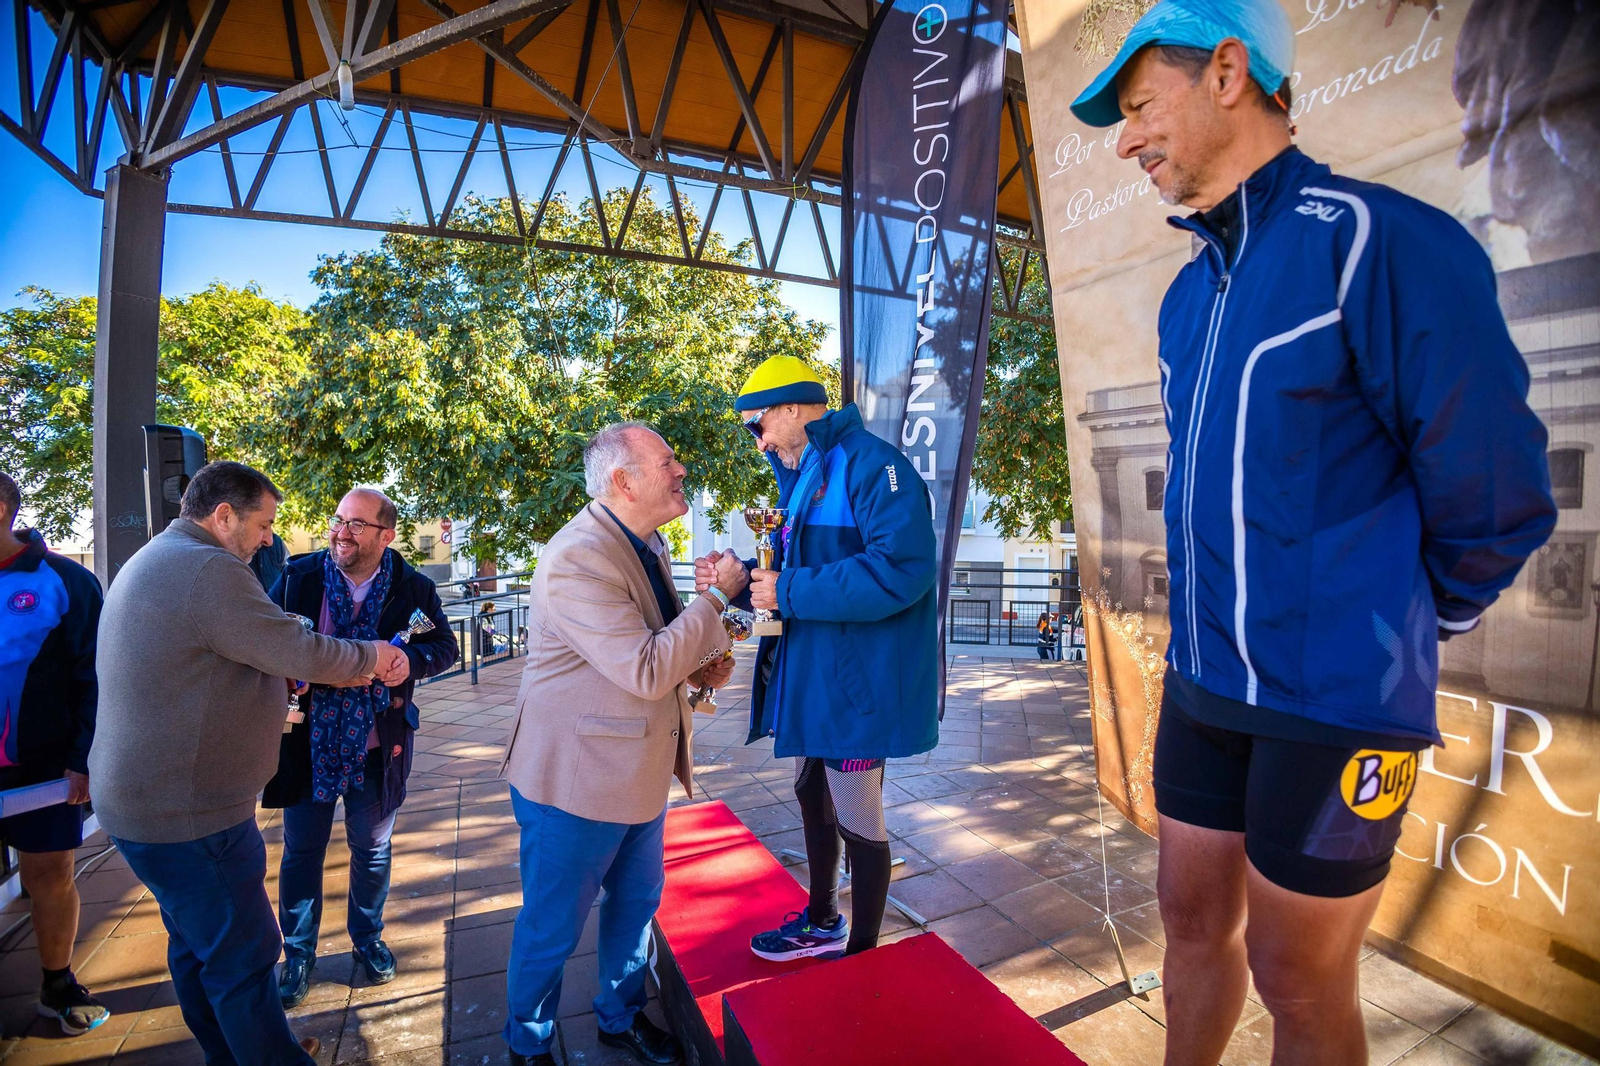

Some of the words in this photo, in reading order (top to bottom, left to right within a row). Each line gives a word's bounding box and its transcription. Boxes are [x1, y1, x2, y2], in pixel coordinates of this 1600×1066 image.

[912, 3, 949, 243] POSITIVO
[1049, 133, 1096, 179] Por
[1060, 175, 1151, 233] Pastora
[901, 249, 936, 520] ESNIVEL
[1417, 690, 1600, 822] ER
